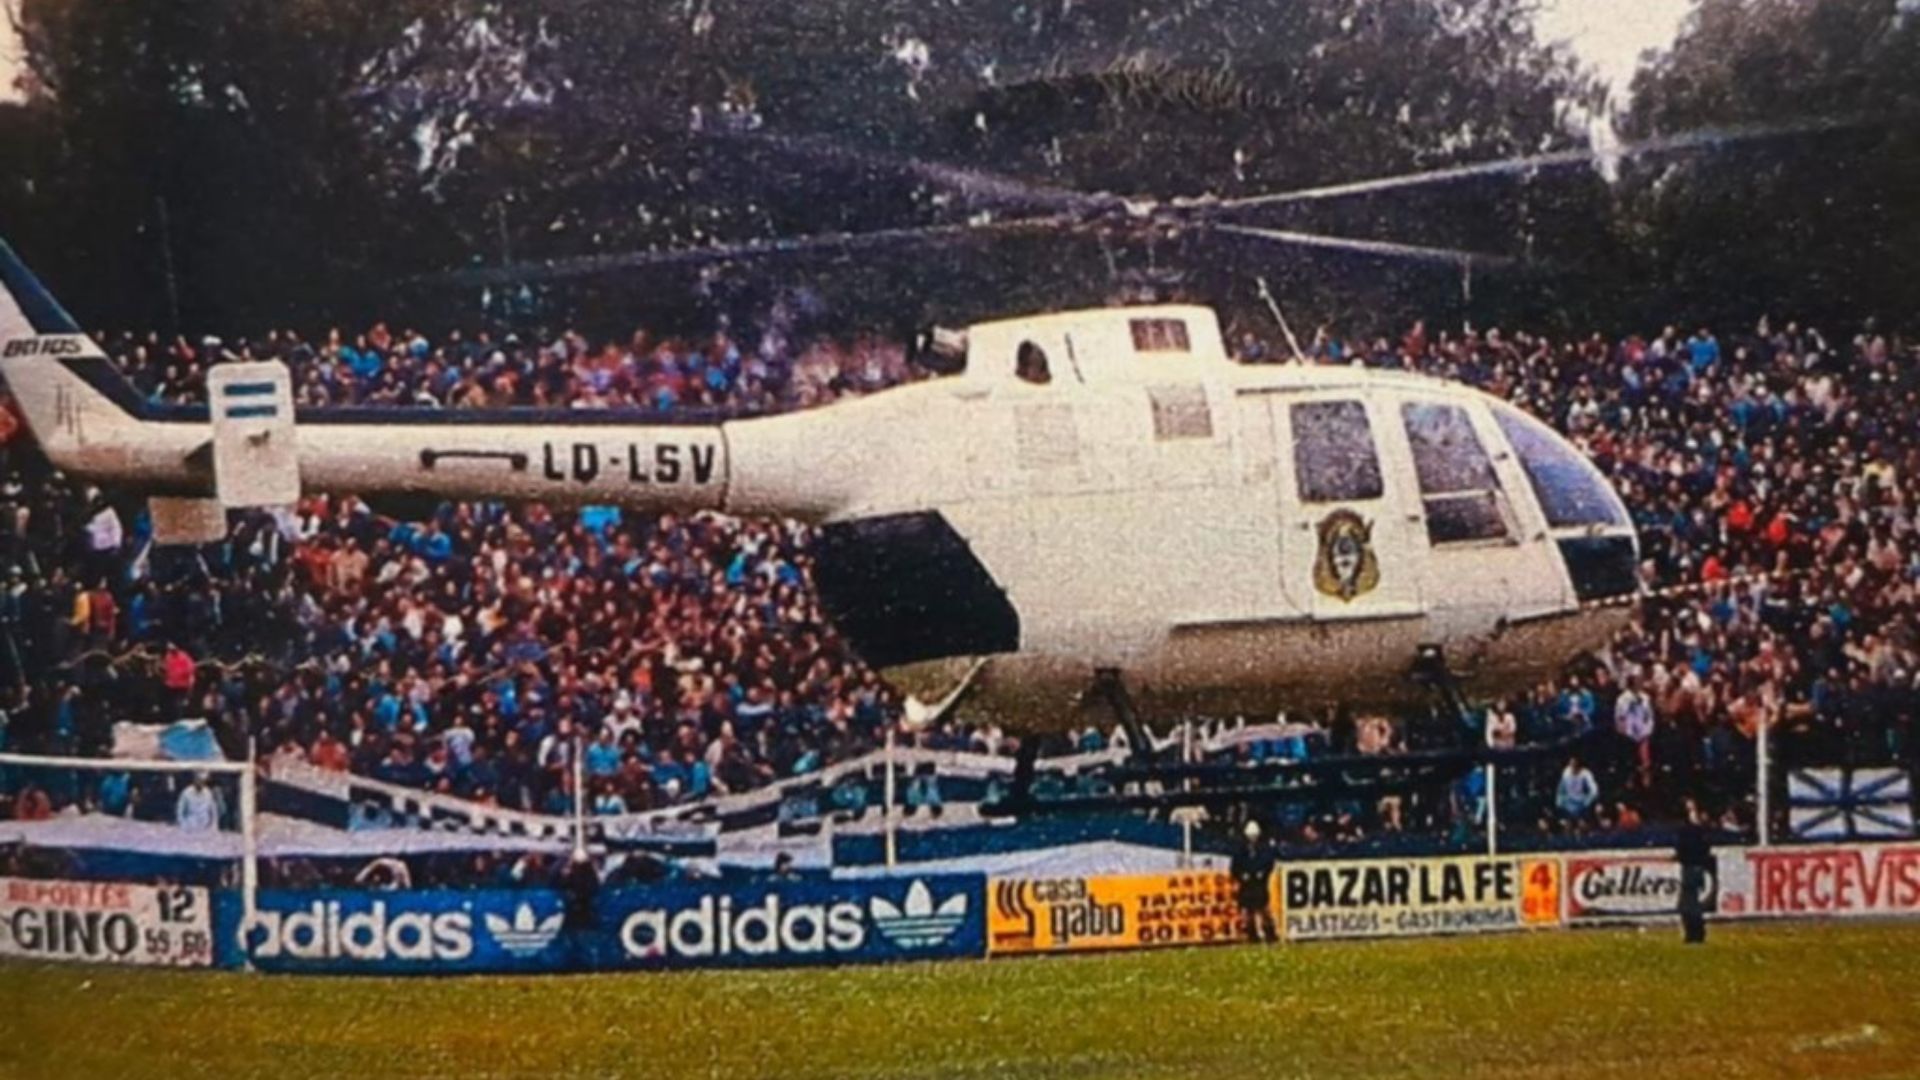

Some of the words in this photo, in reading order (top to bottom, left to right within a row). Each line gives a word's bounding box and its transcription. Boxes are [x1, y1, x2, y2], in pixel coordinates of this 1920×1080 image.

[1032, 876, 1087, 901] casa
[1287, 868, 1410, 909] BAZAR
[1419, 864, 1466, 904] LA
[1474, 861, 1513, 901] FE
[1529, 863, 1552, 891] 4
[157, 888, 197, 922] 12
[620, 894, 864, 958] adidas
[1051, 895, 1125, 944] gabo
[1287, 911, 1379, 934] PLASTICOS
[11, 907, 138, 955] GINO
[236, 900, 473, 960] adidas
